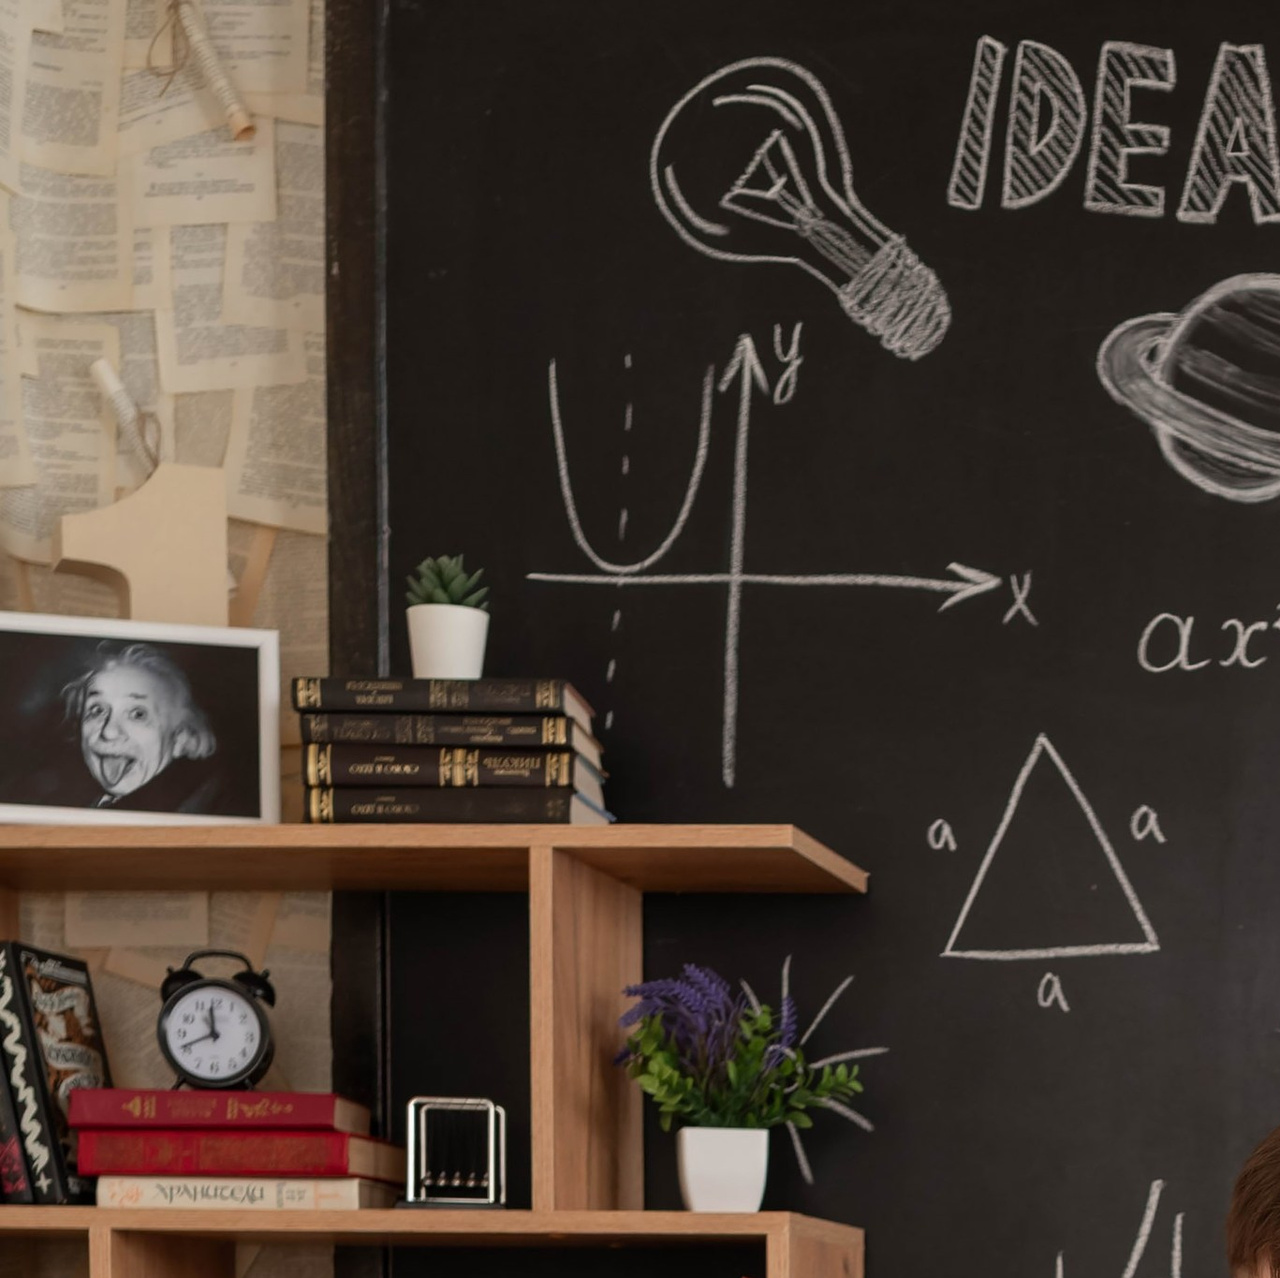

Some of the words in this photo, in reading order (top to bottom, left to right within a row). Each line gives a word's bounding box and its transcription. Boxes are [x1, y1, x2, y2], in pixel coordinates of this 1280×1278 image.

[774, 322, 804, 405] y
[1003, 572, 1038, 625] x
[928, 819, 957, 851] a
[1131, 805, 1166, 843] a
[1038, 972, 1071, 1012] a
